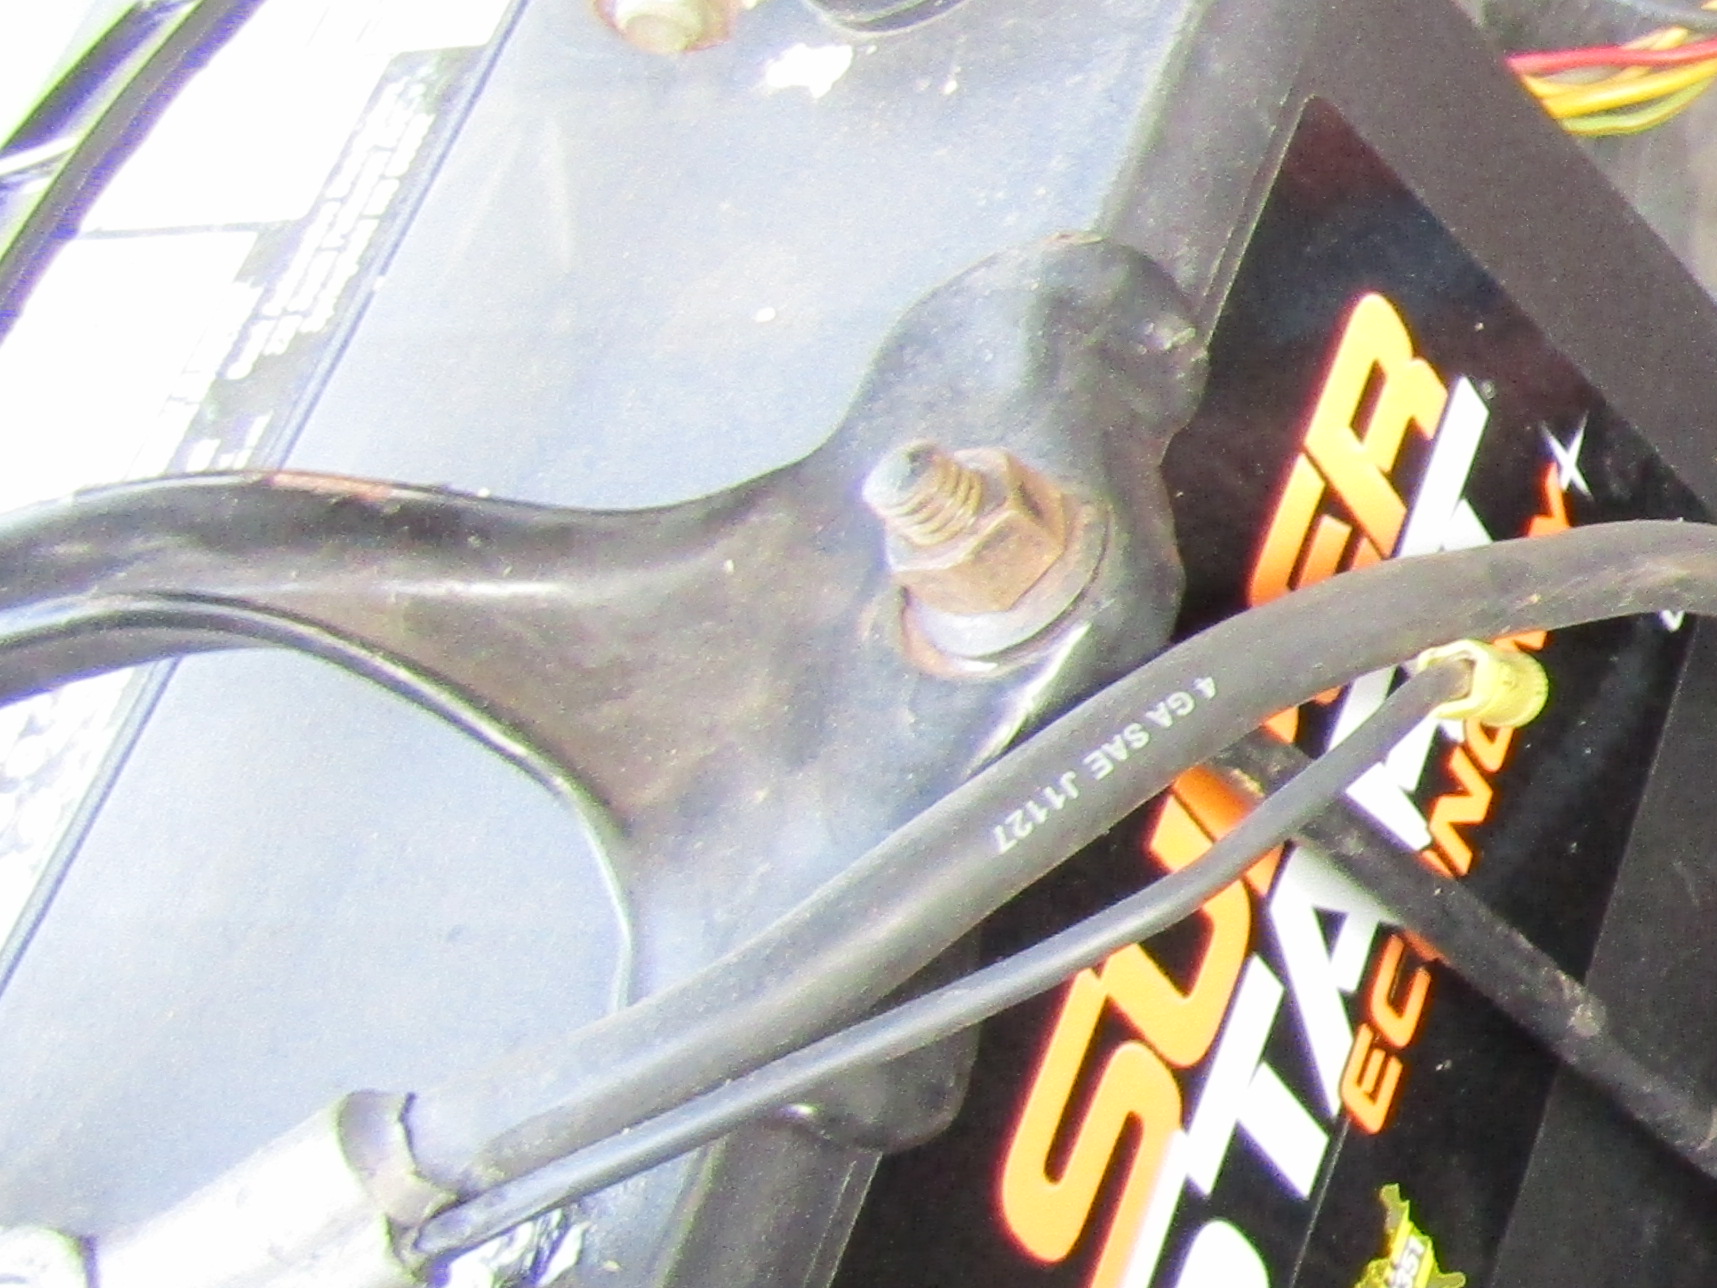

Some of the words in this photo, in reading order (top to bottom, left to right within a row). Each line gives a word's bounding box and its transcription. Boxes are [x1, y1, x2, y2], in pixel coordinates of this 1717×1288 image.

[1144, 691, 1195, 729] GA
[1193, 676, 1217, 700] 4
[1083, 722, 1149, 780] SAE
[993, 770, 1080, 854] J1127
